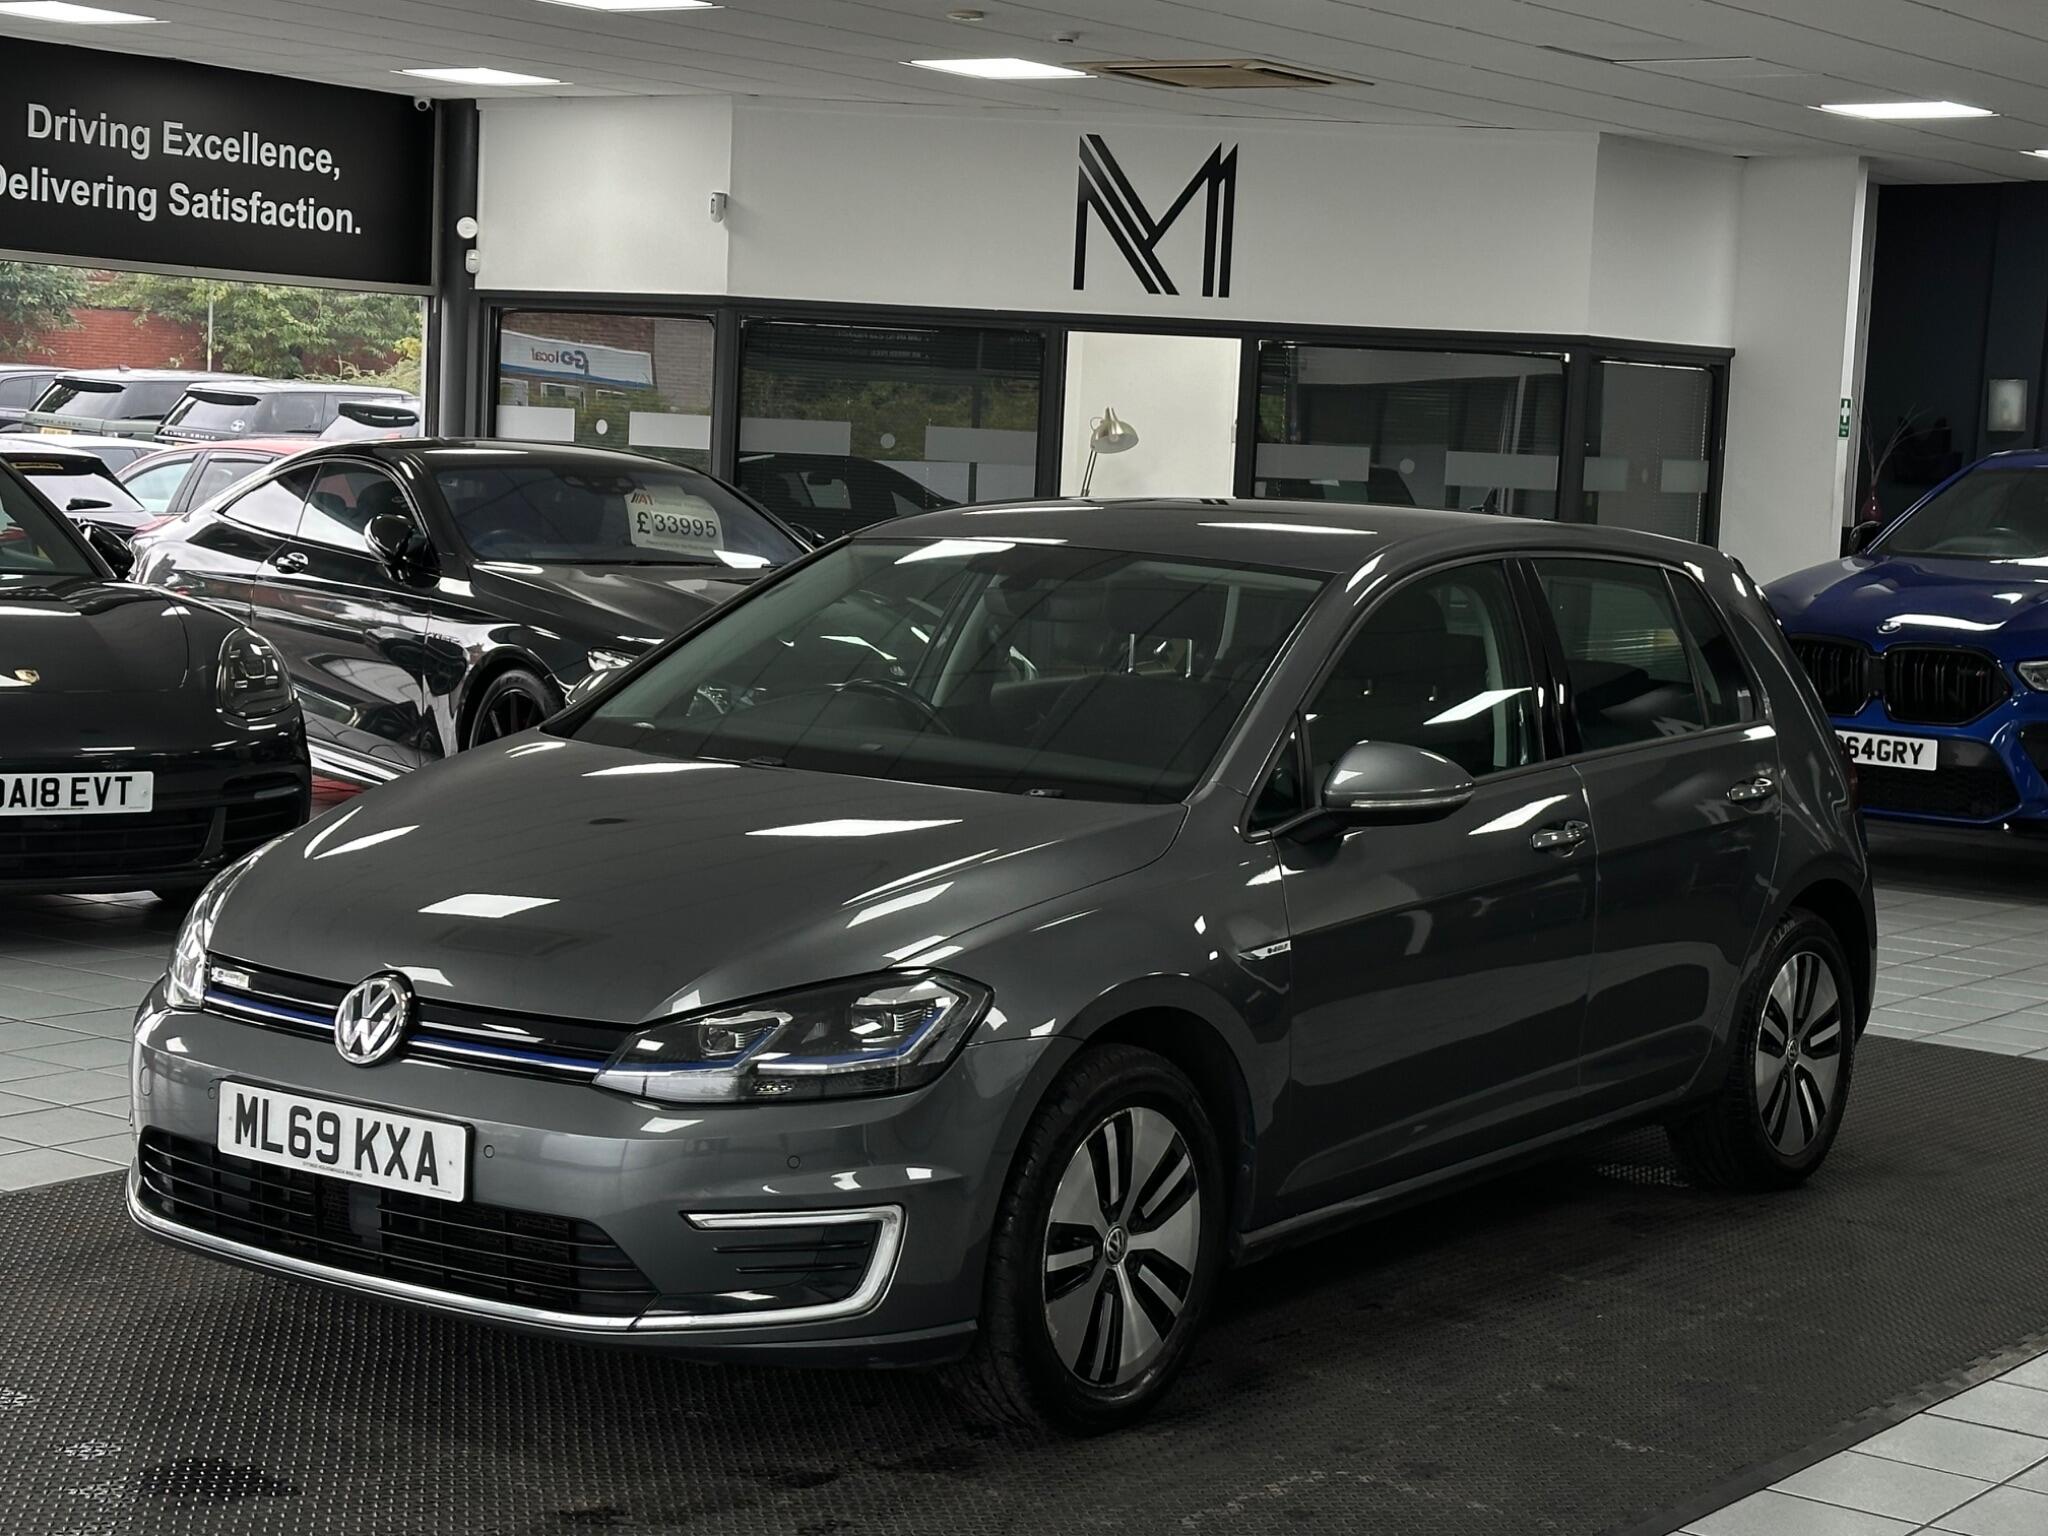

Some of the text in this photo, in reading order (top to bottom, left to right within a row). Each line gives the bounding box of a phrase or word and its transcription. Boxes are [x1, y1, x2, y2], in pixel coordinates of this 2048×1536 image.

[28, 102, 340, 181] Driving Excellence,
[0, 163, 361, 235] elivering Satisfaction.
[636, 511, 718, 538] £33995
[1838, 734, 1924, 765] 64GRY
[0, 775, 133, 808] A18 EVT
[234, 1092, 439, 1187] ML69 KXA
